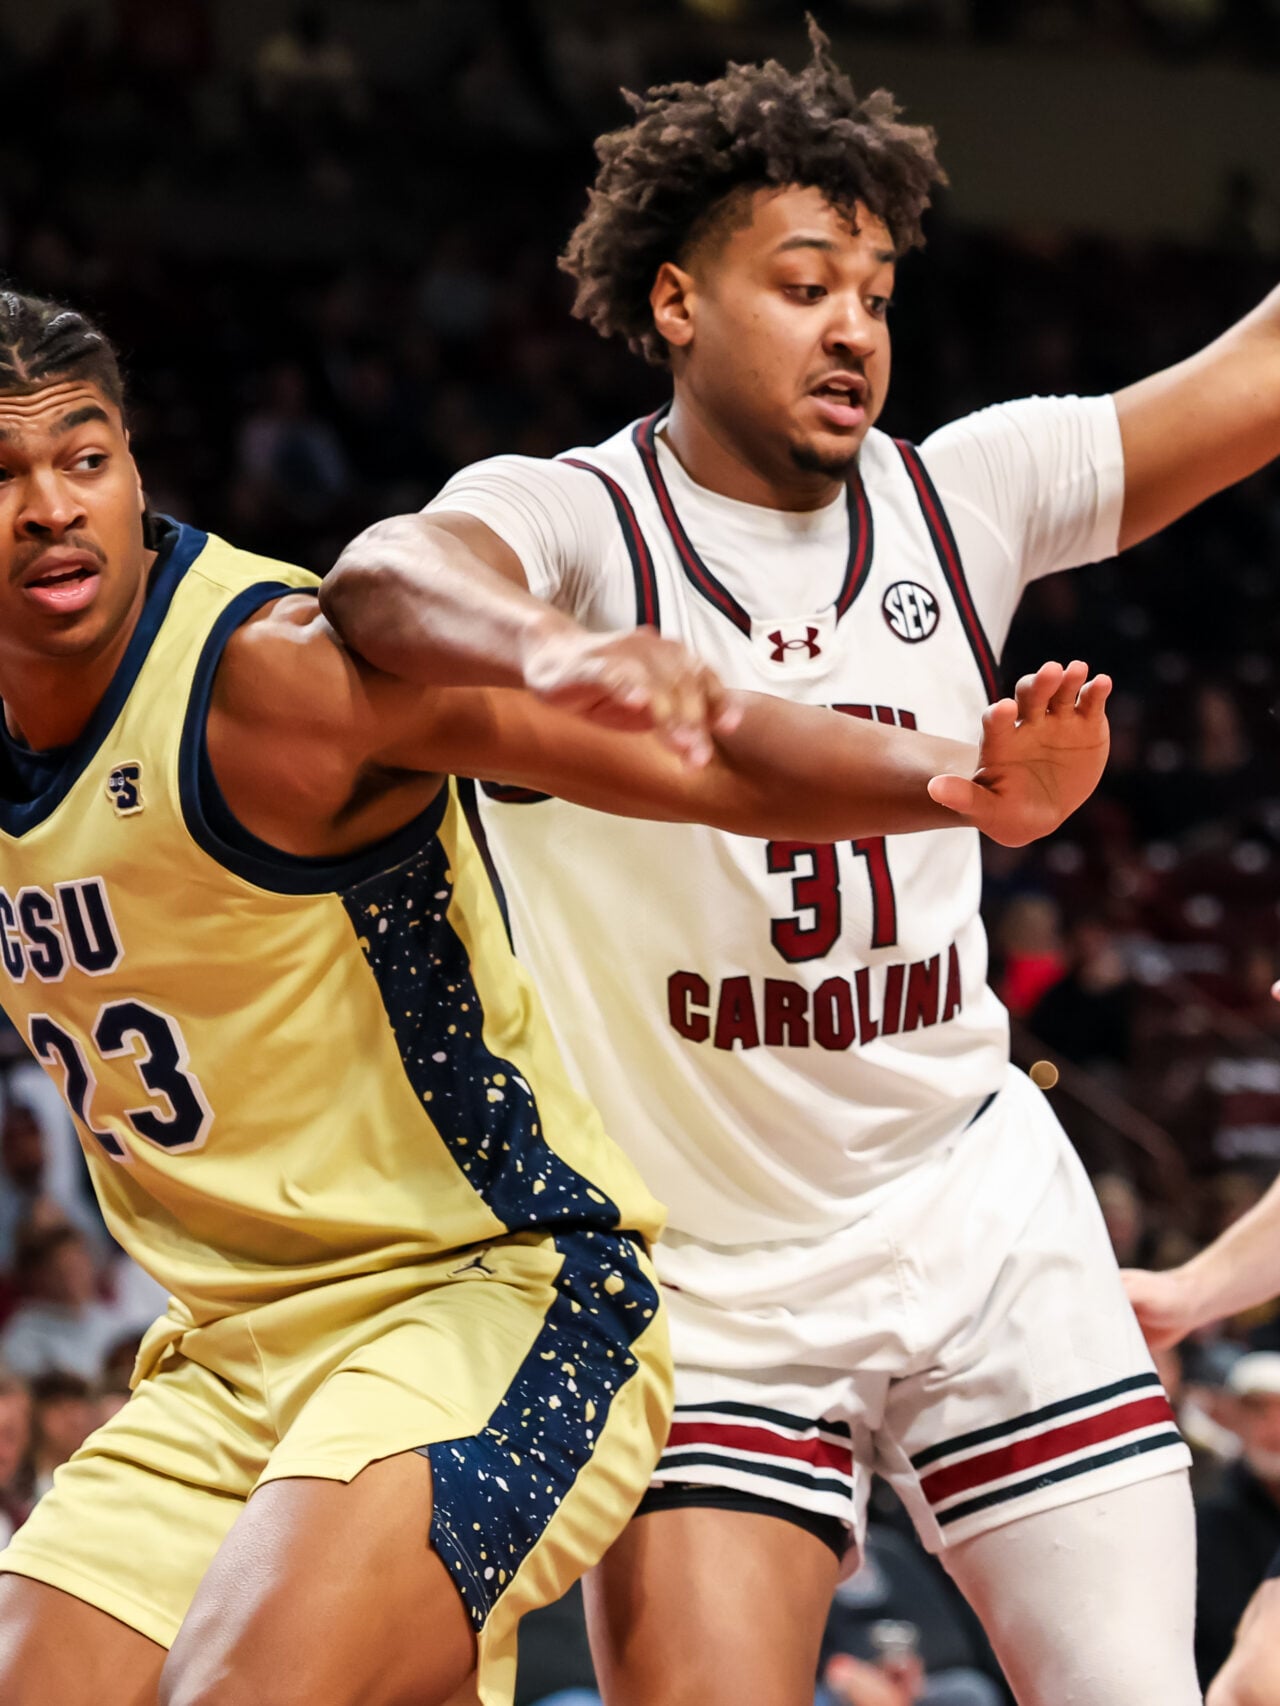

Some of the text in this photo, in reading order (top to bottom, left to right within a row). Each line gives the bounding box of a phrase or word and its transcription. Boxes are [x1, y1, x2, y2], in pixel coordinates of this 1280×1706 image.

[883, 582, 940, 641] SEC
[0, 876, 125, 983] CSU
[766, 835, 897, 964] 31
[667, 939, 962, 1051] CAROLINA
[28, 997, 215, 1163] 23
